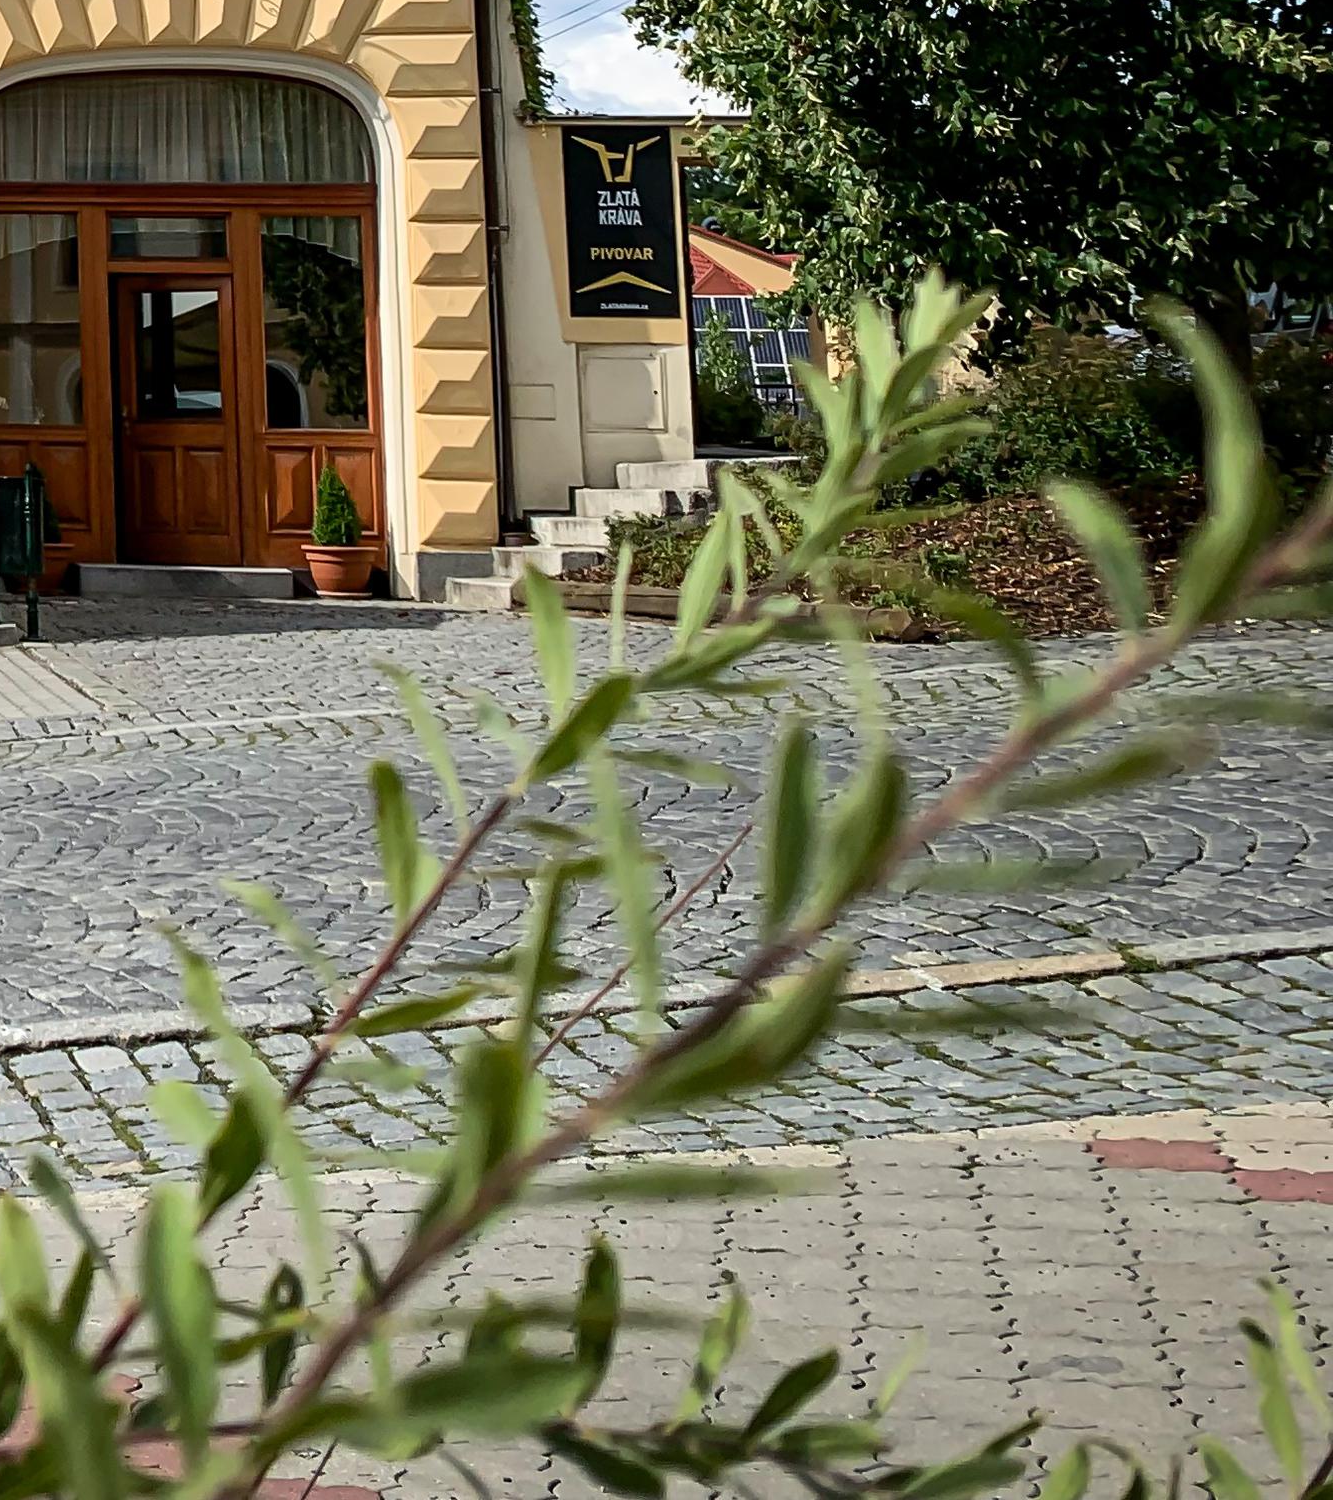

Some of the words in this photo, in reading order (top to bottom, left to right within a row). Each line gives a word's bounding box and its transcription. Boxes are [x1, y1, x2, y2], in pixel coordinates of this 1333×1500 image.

[597, 188, 641, 207] ZLATÁ
[598, 207, 643, 226] KRÁVA
[590, 247, 654, 260] PIVOVAR
